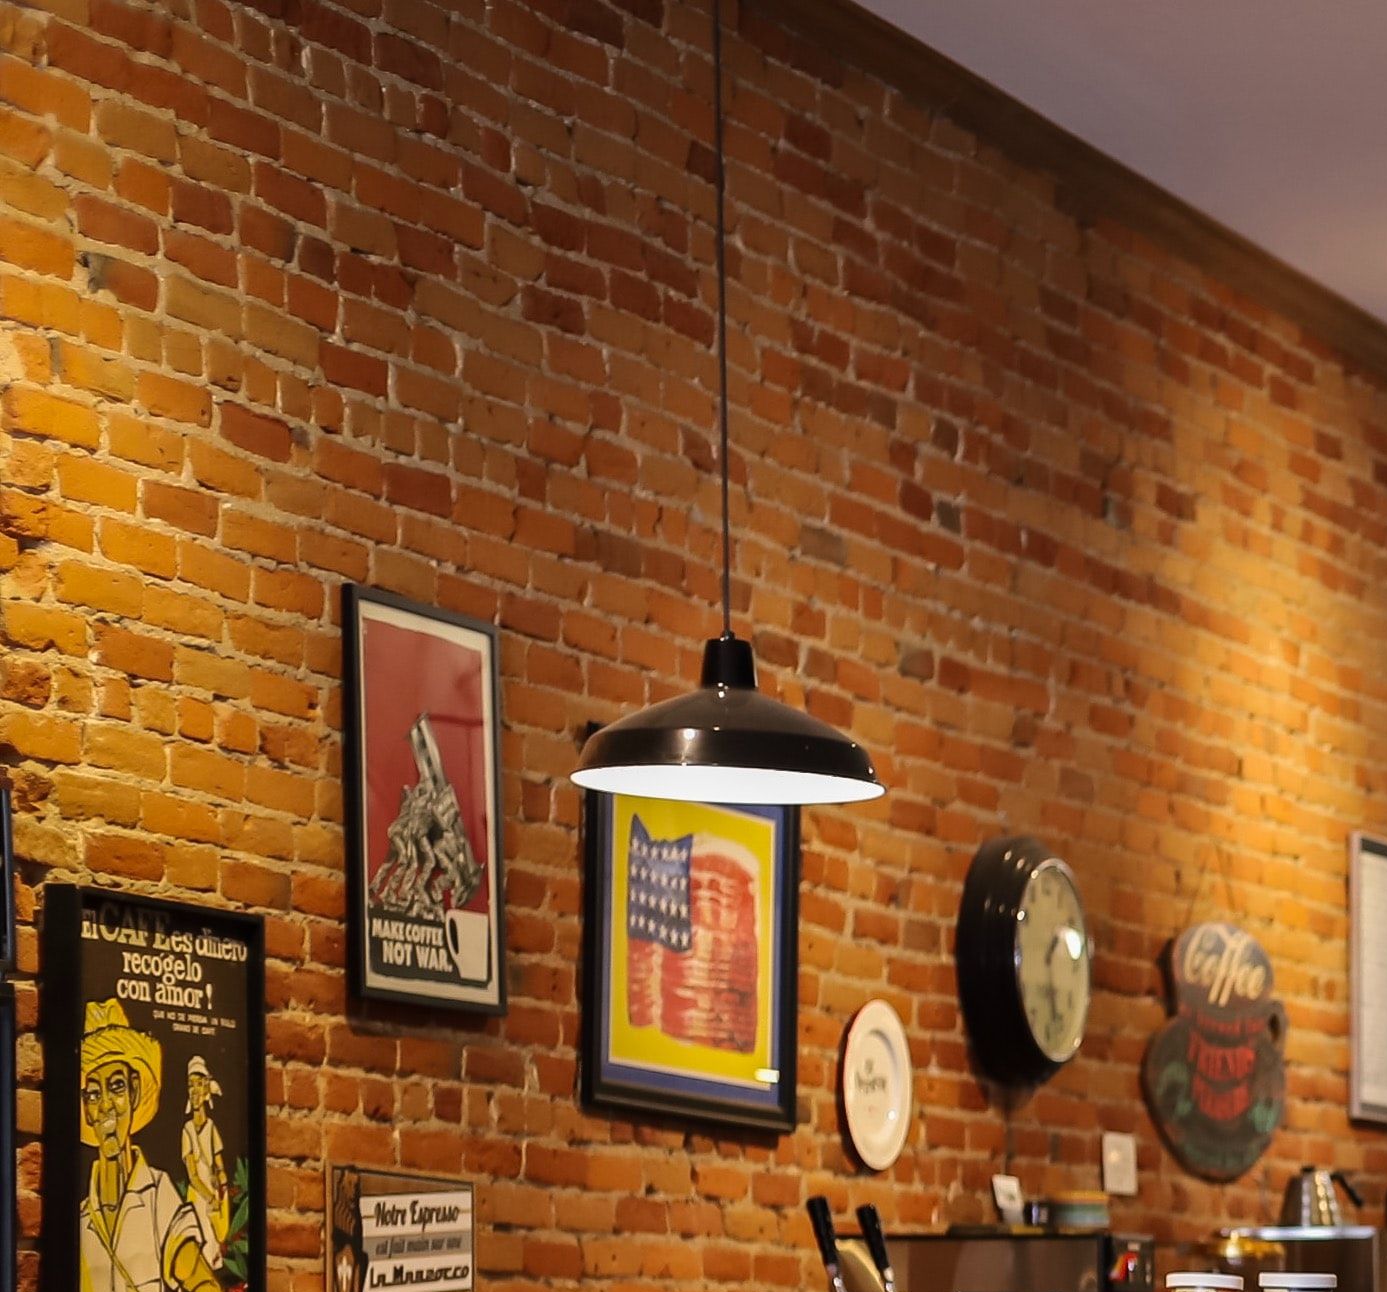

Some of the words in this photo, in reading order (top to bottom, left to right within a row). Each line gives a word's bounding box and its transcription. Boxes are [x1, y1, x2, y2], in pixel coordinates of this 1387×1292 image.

[372, 918, 405, 941] MAKE
[405, 923, 444, 946] COFFEE
[383, 940, 413, 967] NOT
[416, 945, 453, 973] WAR.
[117, 979, 151, 1004] con
[374, 1201, 407, 1228] Notre
[409, 1199, 460, 1232] Espresso
